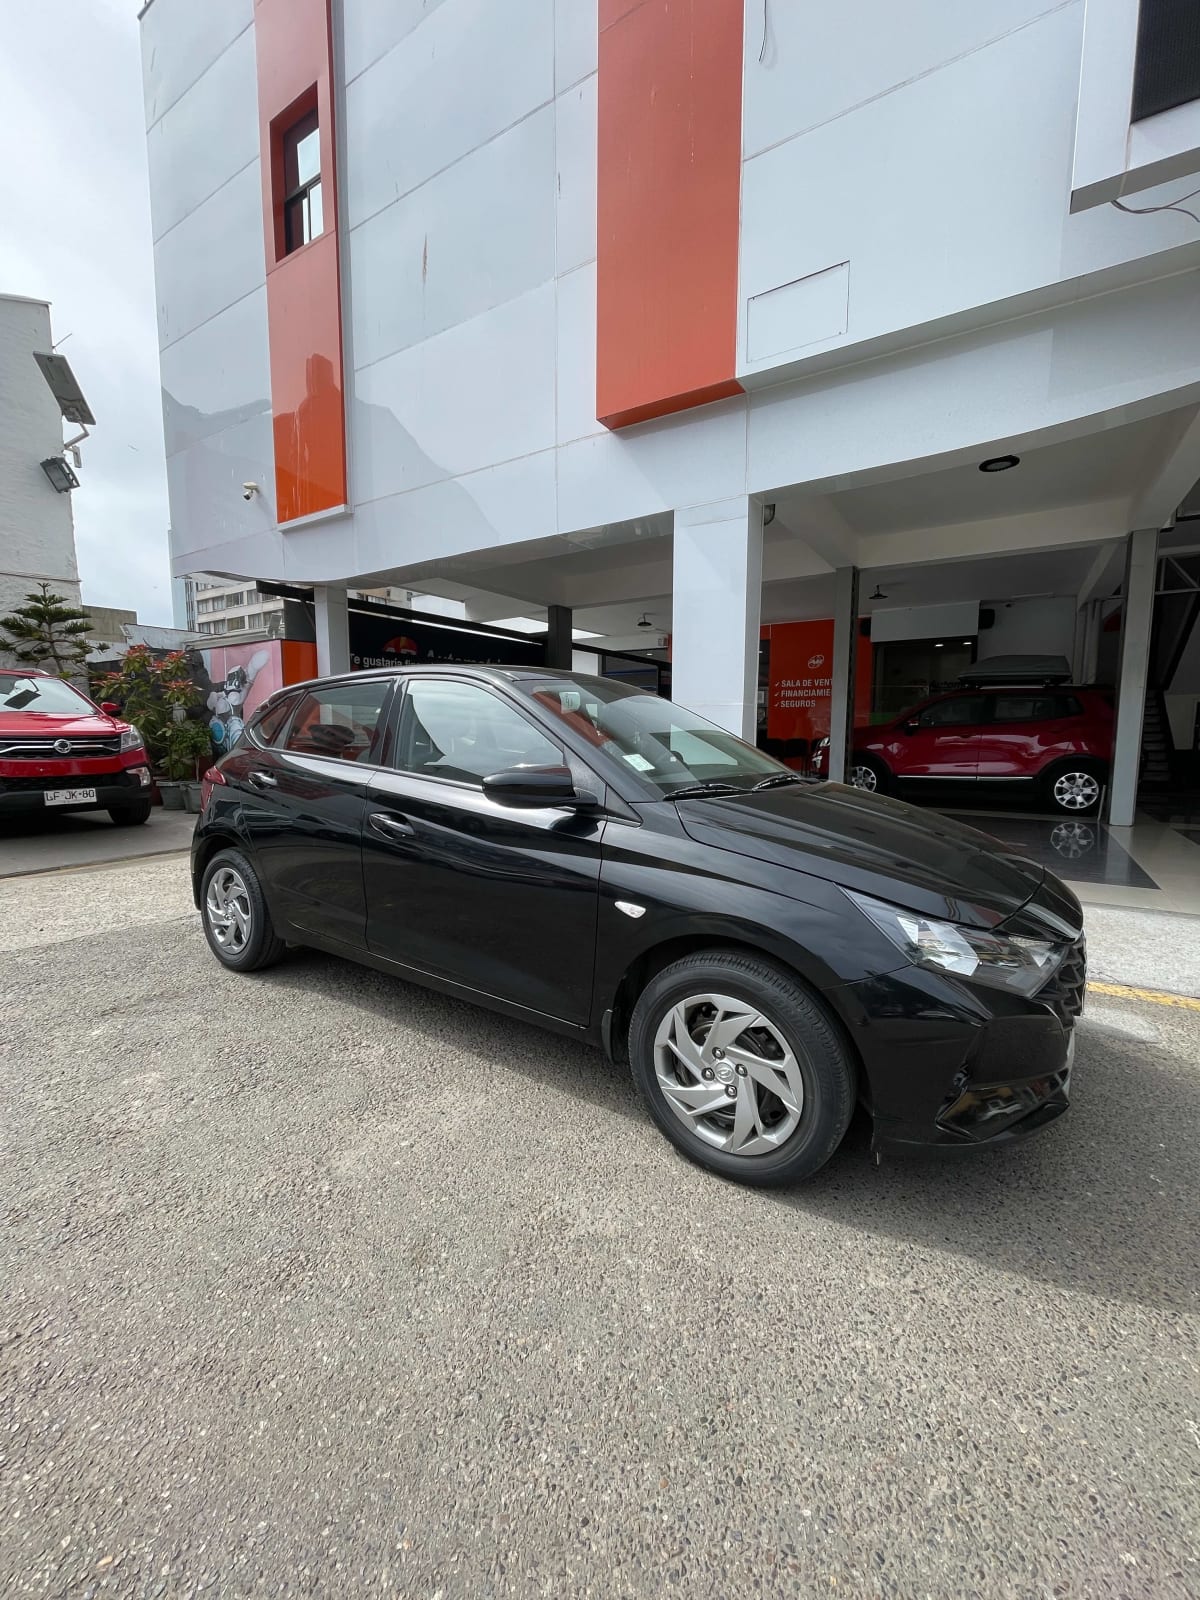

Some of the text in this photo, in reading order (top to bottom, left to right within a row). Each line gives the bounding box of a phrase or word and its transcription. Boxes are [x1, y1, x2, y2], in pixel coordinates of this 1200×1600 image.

[781, 679, 800, 687] SALA
[802, 679, 812, 687] DE
[780, 700, 816, 708] SEGUROS
